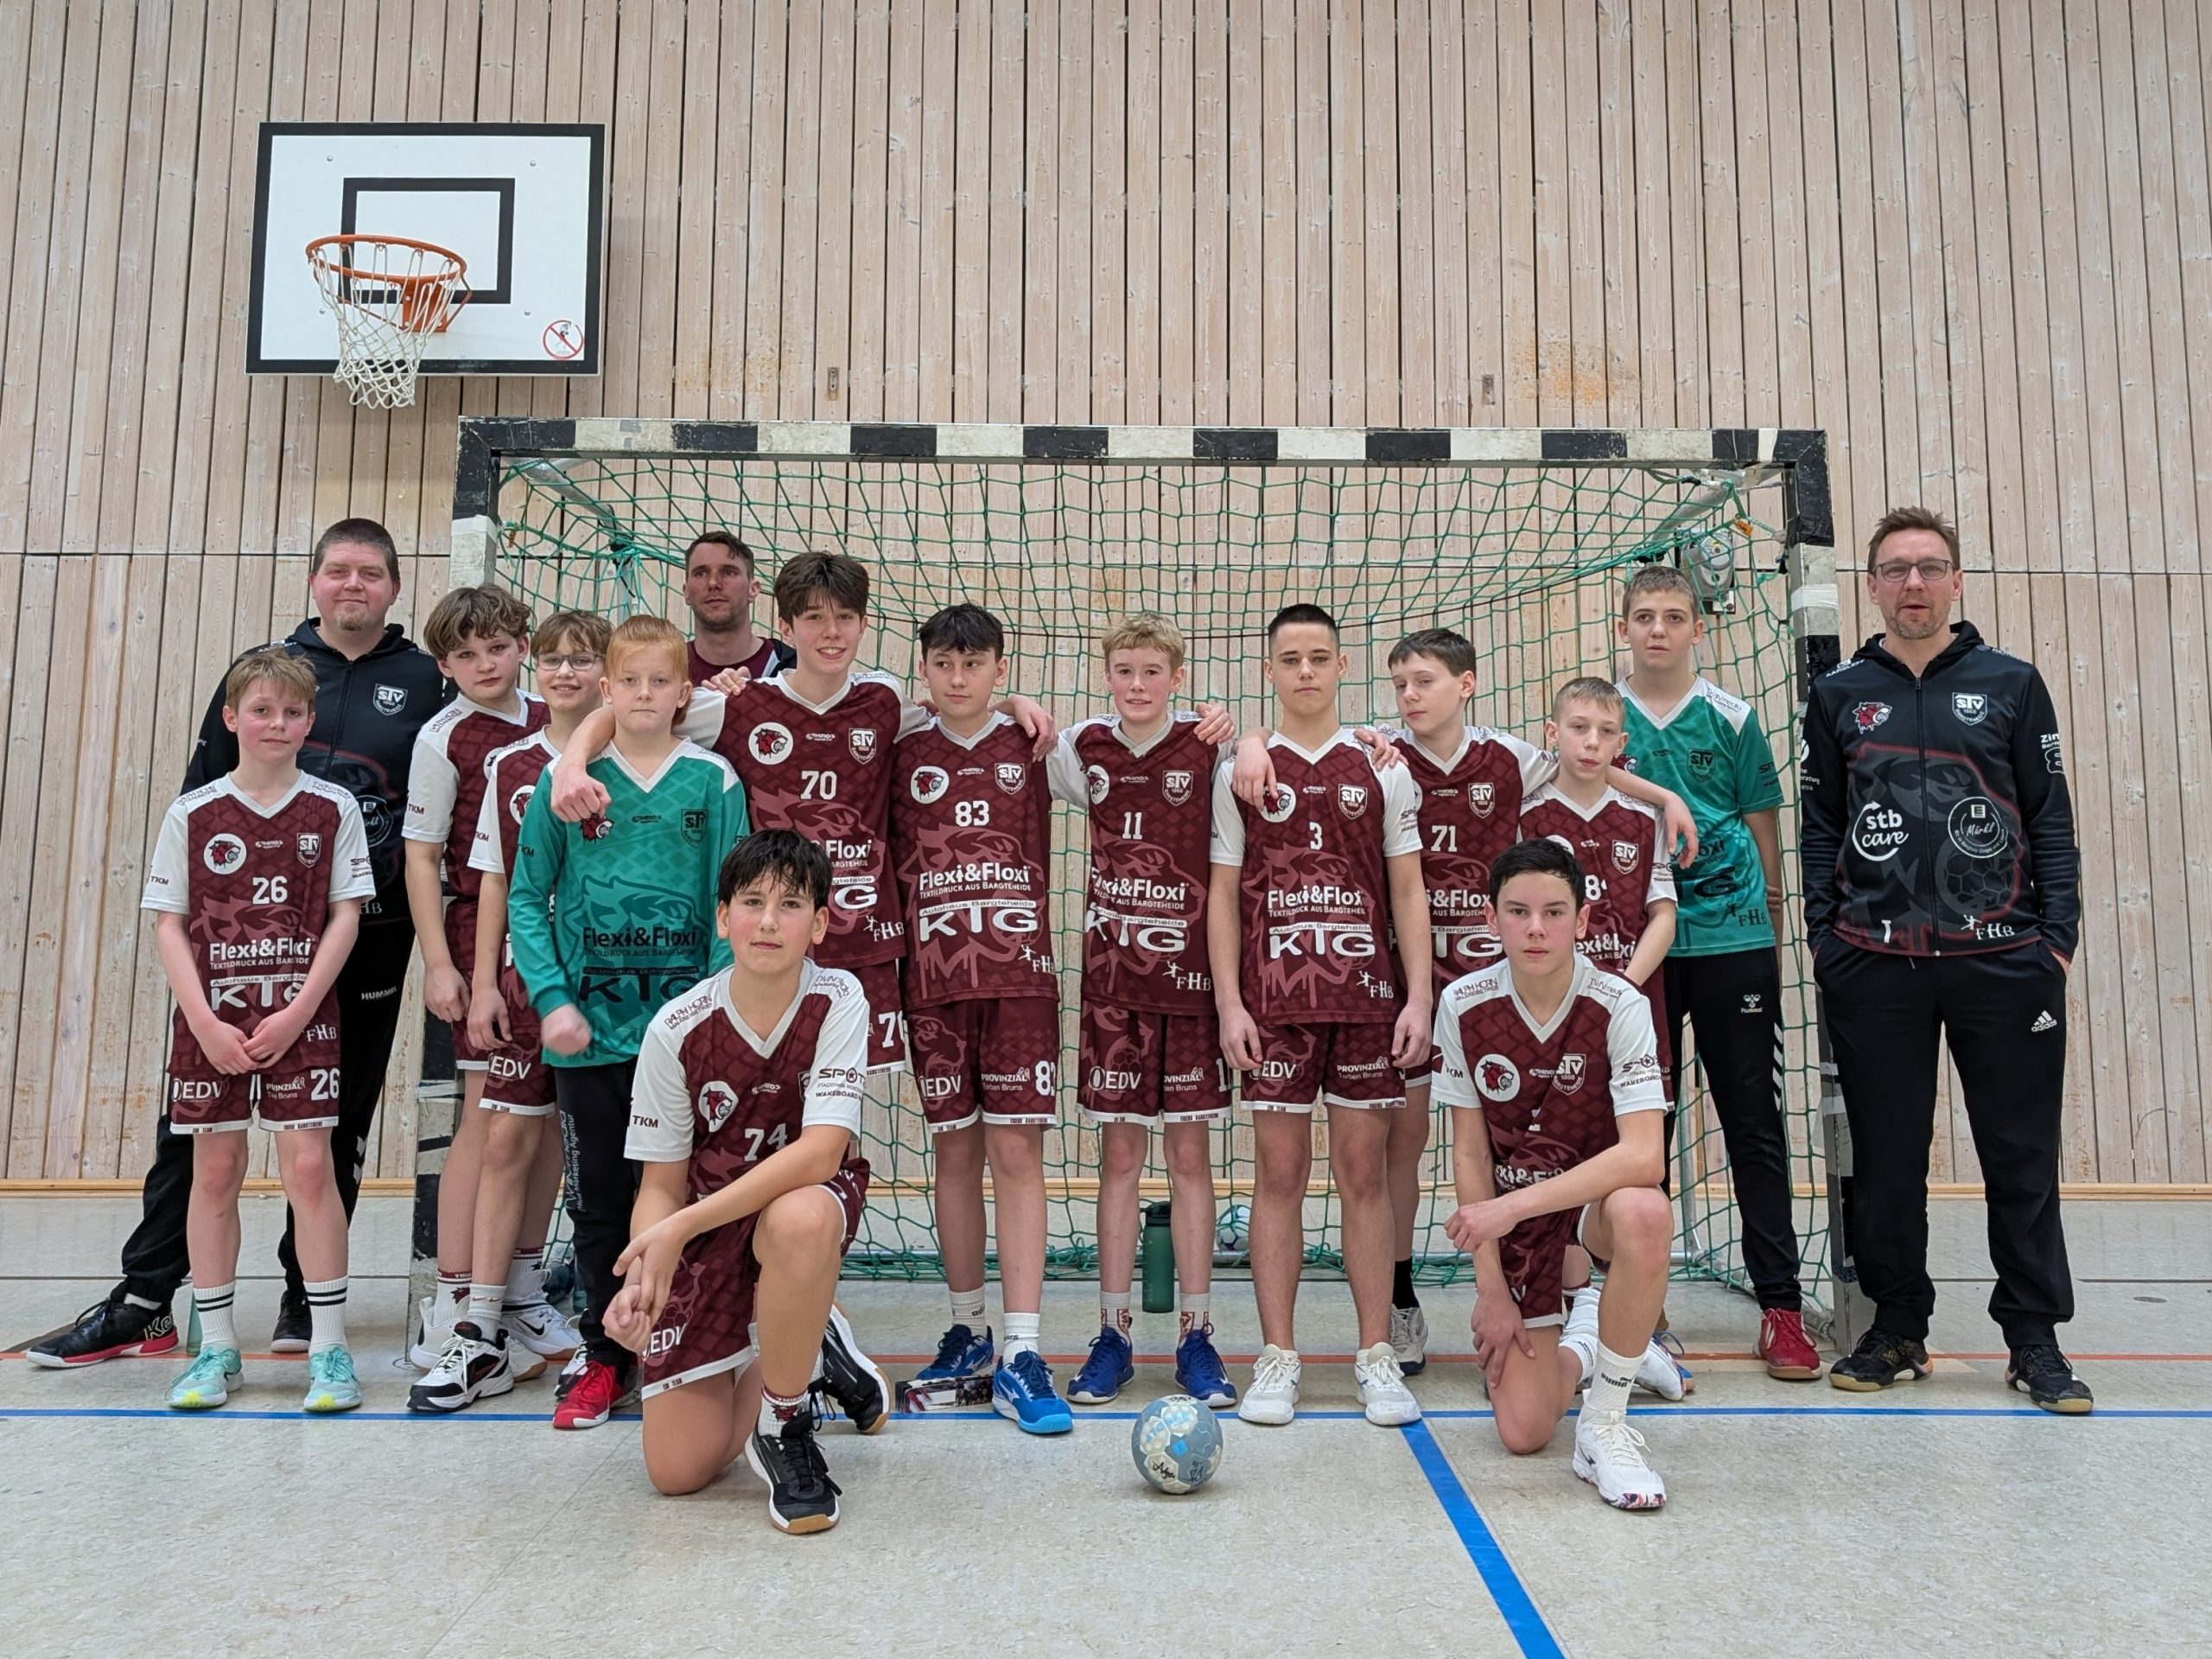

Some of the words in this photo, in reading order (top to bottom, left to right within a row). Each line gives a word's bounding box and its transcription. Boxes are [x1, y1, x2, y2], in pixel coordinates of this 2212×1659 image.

[378, 686, 404, 702] STV
[1955, 694, 1984, 709] STV
[851, 730, 874, 747] STV
[1690, 750, 1713, 766] STV
[997, 765, 1022, 779] STV
[1165, 772, 1191, 788] STV
[800, 770, 838, 800] 70
[1471, 785, 1492, 801] STV
[1340, 786, 1365, 803] STV
[408, 804, 425, 815] TKM
[955, 800, 989, 827] 83
[1122, 811, 1143, 840] 11
[1866, 809, 1903, 830] stb
[1309, 822, 1323, 851] 3
[1431, 825, 1458, 852] 71
[1966, 822, 1995, 837] Märkl
[298, 834, 321, 851] STV
[1861, 830, 1910, 848] care
[518, 844, 535, 857] TKM
[810, 839, 872, 859] Floxi
[1614, 842, 1637, 860] STV
[150, 875, 169, 886] TKM
[919, 862, 1029, 891] Flexi&Floxi
[252, 876, 288, 905] 26
[919, 884, 963, 899] TEXTILDRUCK
[982, 881, 1031, 892] BARGTEHEIDE
[922, 902, 968, 915] Autohaus
[1132, 899, 1185, 910] BARGTEHEIDE
[919, 907, 1037, 942] KTG
[1738, 908, 1767, 927] FHB
[583, 926, 696, 947] Flexi&Floxi
[874, 921, 905, 942] FHB
[1085, 910, 1185, 952] KTG
[1975, 923, 2016, 941] FHB
[1269, 929, 1376, 959] KTG
[1436, 931, 1503, 957] TG
[1176, 972, 1211, 991] FHB
[1370, 981, 1394, 998] FHB
[1474, 977, 1497, 988] HORN
[688, 994, 712, 1011] HORN
[306, 1024, 337, 1042] FHB
[2031, 1019, 2057, 1033] adidas
[1337, 1063, 1387, 1072] PROVINZIAL
[1557, 1054, 1584, 1075] STV
[310, 1068, 340, 1101] 26
[981, 1073, 1027, 1083] PROVINZIAL
[816, 1090, 858, 1100] WAKEBOARD
[632, 1115, 658, 1128] TKM
[568, 1114, 578, 1148] Agentur
[744, 1123, 788, 1162] 74
[571, 1149, 581, 1192] Marketing
